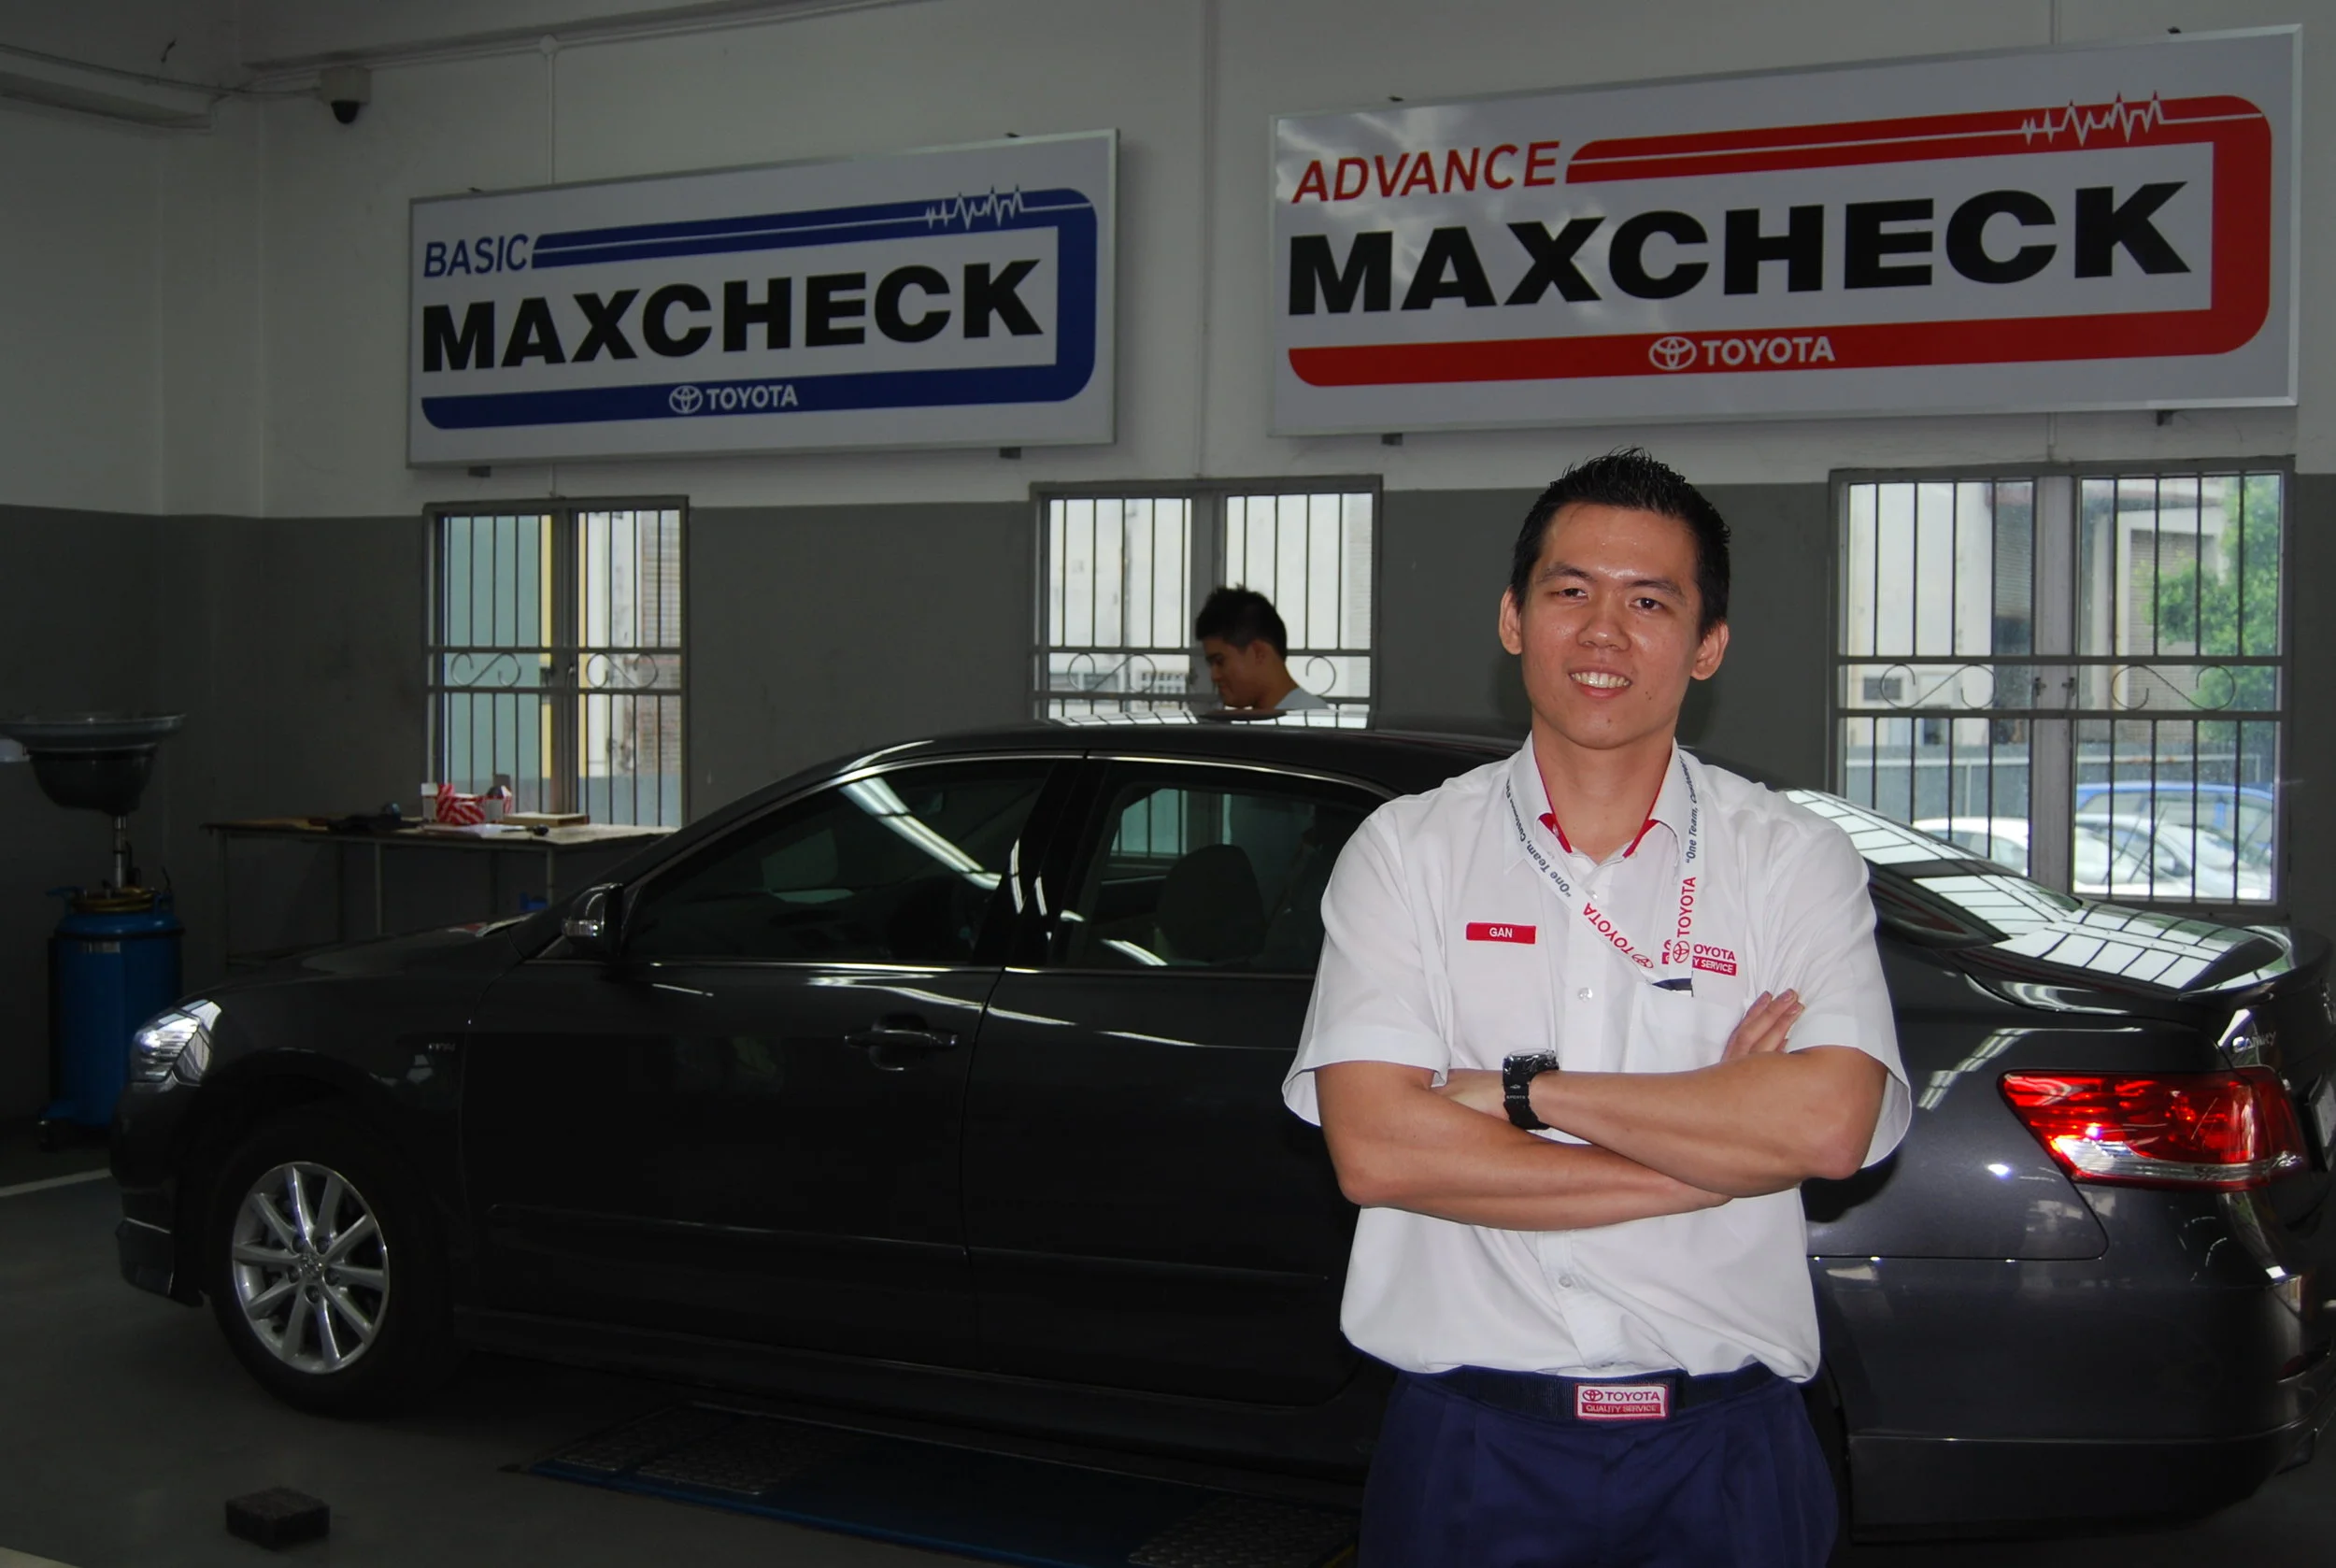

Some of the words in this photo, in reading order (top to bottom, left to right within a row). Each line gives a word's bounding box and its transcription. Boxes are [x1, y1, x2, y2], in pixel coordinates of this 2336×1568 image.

[1293, 141, 1560, 204] ADVANCE
[423, 233, 529, 278] BASIC
[1289, 181, 2192, 315] MAXCHECK
[422, 259, 1043, 372] MAXCHECK
[1702, 335, 1835, 366] TOYOTA
[706, 384, 799, 412] TOYOTA
[1676, 877, 1697, 938] TOYOTA
[1489, 927, 1513, 938] GAN
[1583, 903, 1634, 954] TOYOTA
[1693, 944, 1735, 962] OYOTA
[1701, 959, 1733, 973] SERVICE
[1586, 1404, 1621, 1413] QUALITY
[1605, 1391, 1659, 1401] TOYOTA
